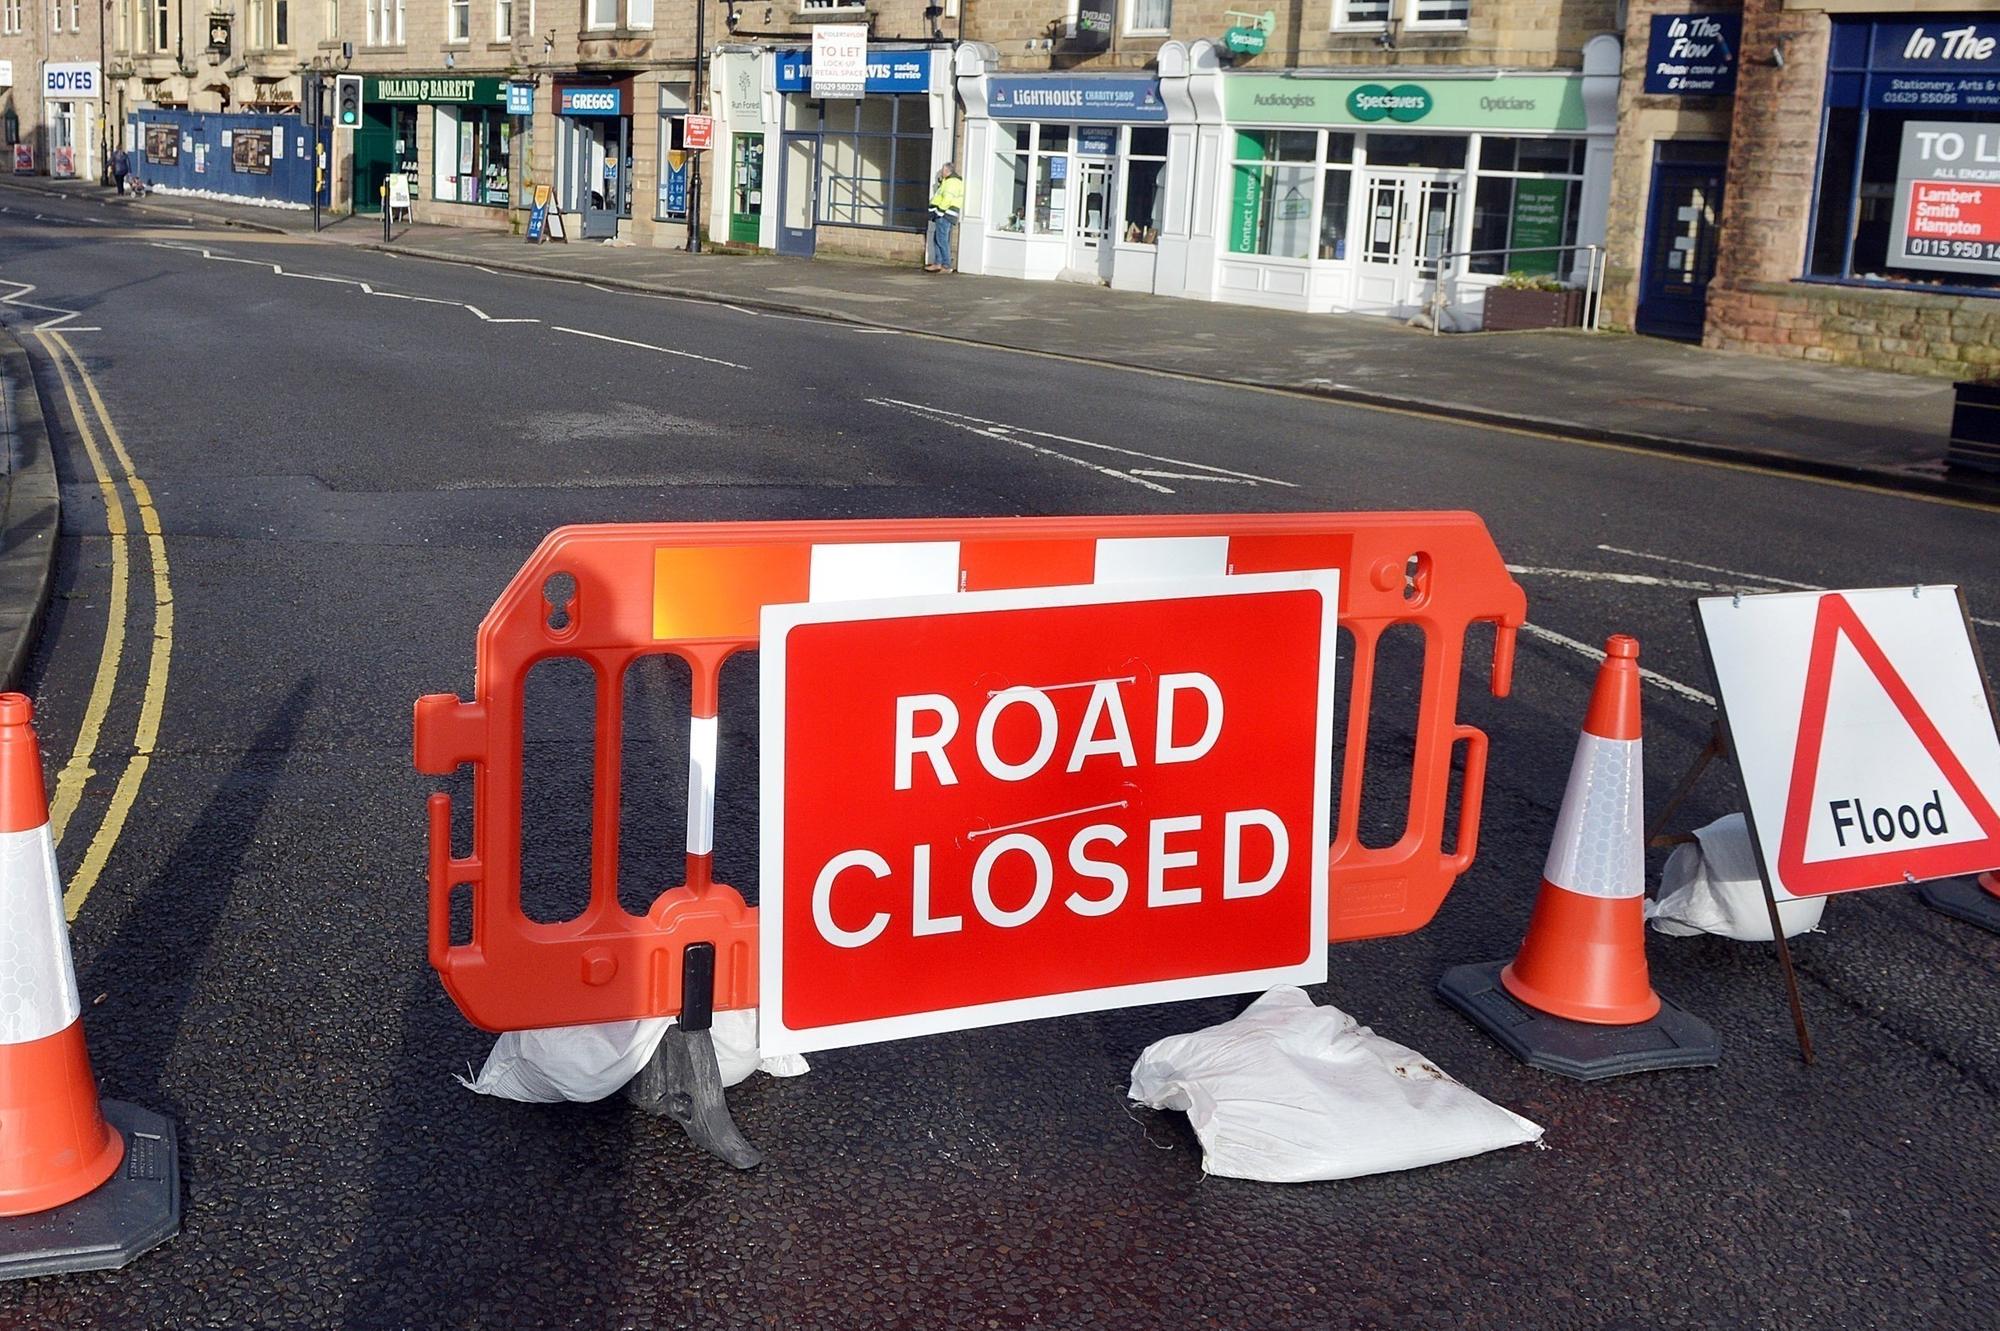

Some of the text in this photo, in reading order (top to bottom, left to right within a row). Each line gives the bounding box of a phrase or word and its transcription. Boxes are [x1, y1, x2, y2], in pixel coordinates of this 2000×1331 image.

[1667, 16, 1721, 38] In The
[820, 46, 861, 57] TO LET
[1669, 37, 1714, 58] Flow
[1903, 25, 1996, 60] In The
[894, 62, 920, 72] racing
[48, 71, 92, 90] BOYES
[1957, 80, 1984, 91] Arts
[1985, 80, 1996, 91] &
[378, 80, 475, 100] HOLLAND & BARRETT
[1085, 90, 1113, 101] CHARITY
[1883, 92, 1918, 104] 01629
[572, 93, 614, 110] GREGGS
[1253, 93, 1315, 109] Audiologists
[1356, 93, 1425, 110] Specsavers
[1480, 96, 1536, 111] Opticians
[1916, 131, 2000, 162] TO L
[1933, 168, 1957, 178] ALL
[1919, 187, 1983, 205] Lambert
[1916, 202, 1960, 219] Smith
[1240, 209, 1254, 252] Contact
[1914, 217, 1982, 237] Hampton
[1911, 238, 1950, 256] 0115
[1952, 241, 1983, 259] 950
[893, 671, 1225, 791] ROAD
[1829, 789, 1949, 848] Flood
[810, 808, 1290, 949] CLOSED
